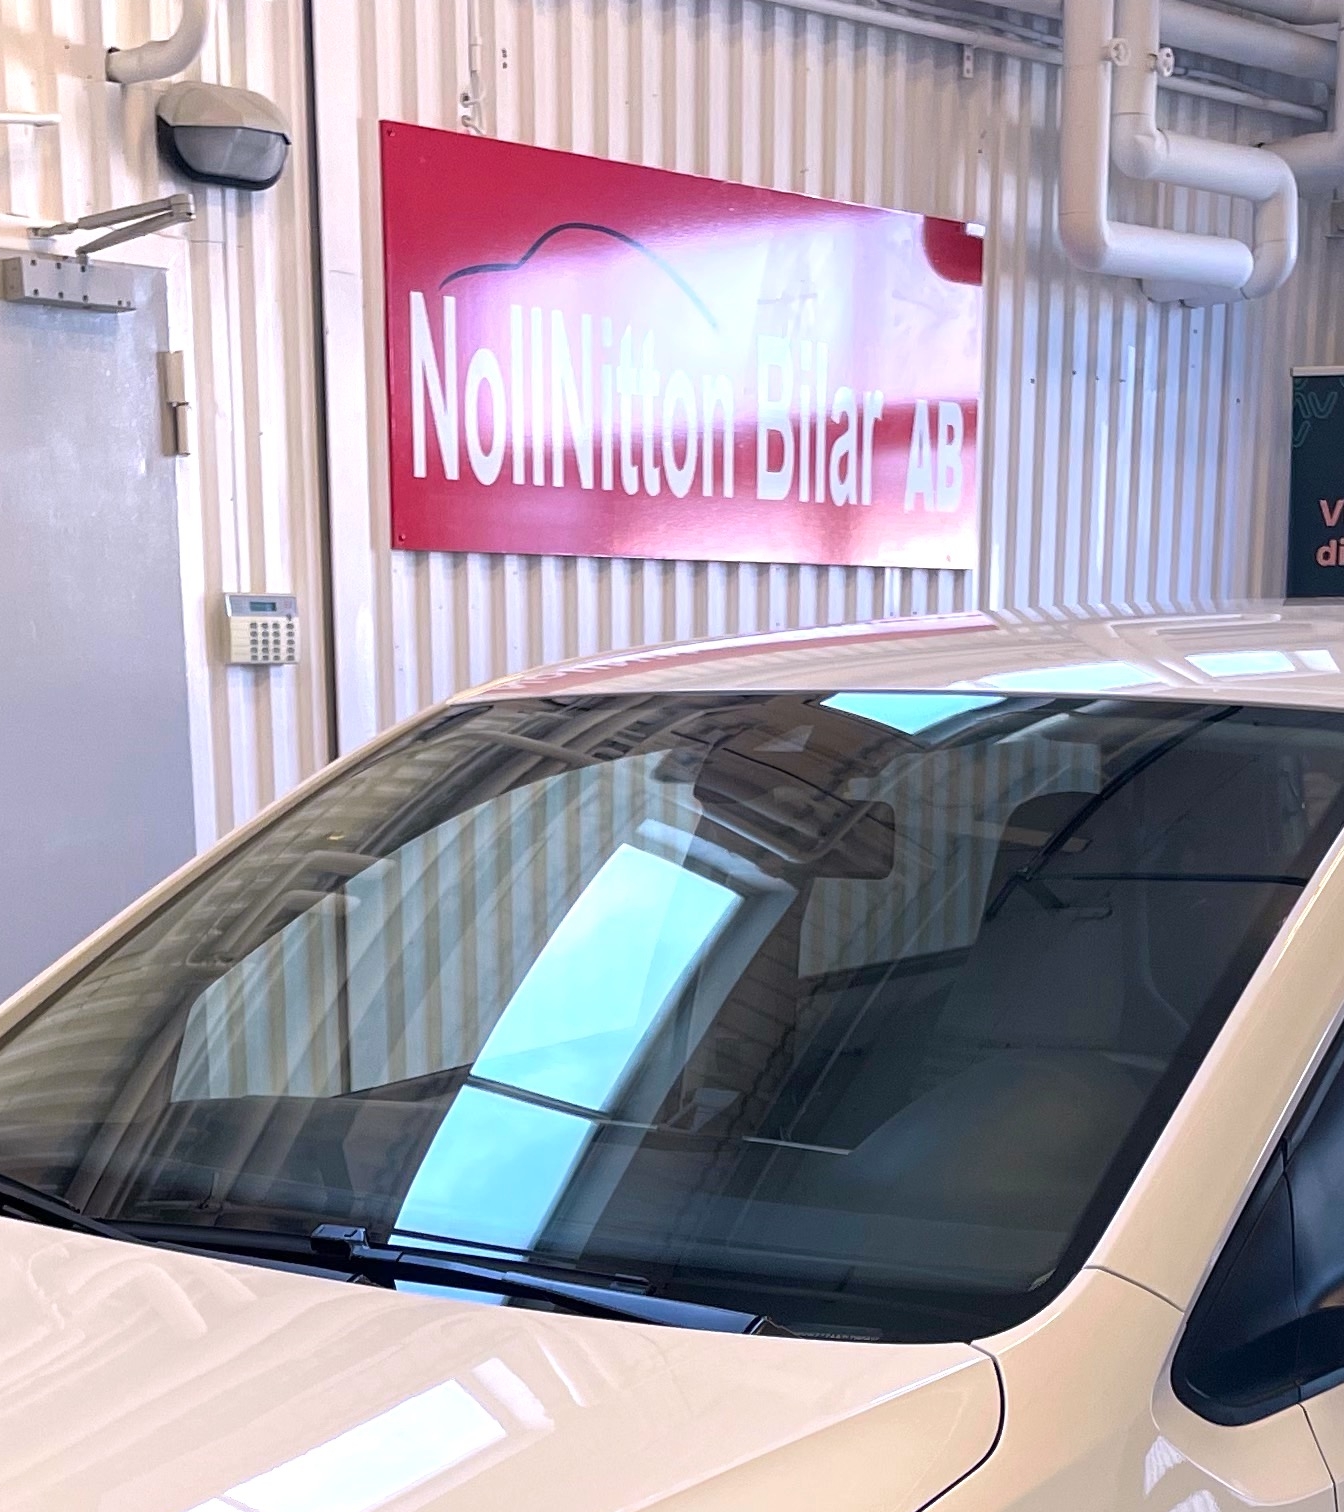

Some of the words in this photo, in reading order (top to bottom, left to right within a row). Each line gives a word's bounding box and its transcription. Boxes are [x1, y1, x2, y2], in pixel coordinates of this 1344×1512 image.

[409, 290, 735, 499] NollNitton
[755, 333, 885, 507] Bilar
[904, 399, 965, 512] AB
